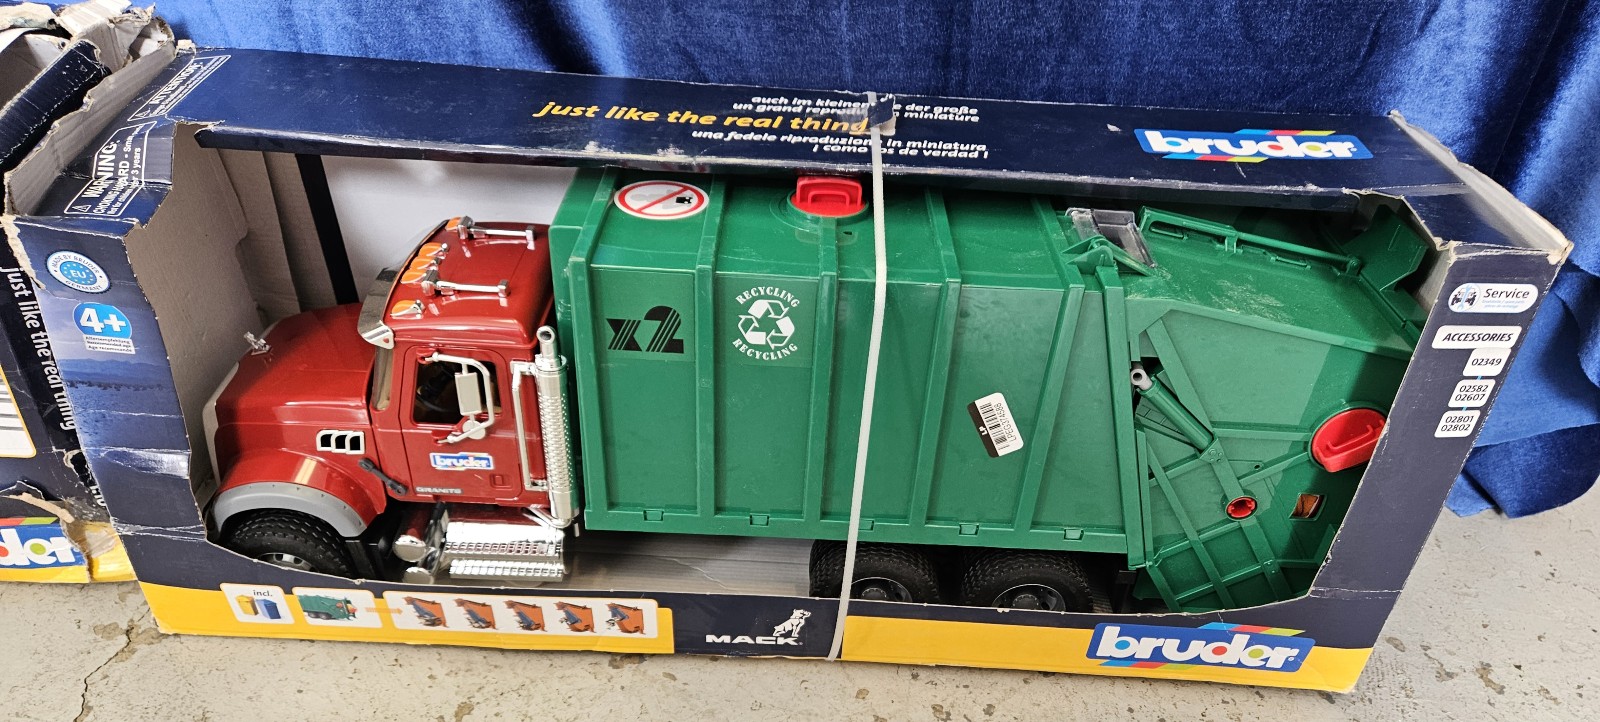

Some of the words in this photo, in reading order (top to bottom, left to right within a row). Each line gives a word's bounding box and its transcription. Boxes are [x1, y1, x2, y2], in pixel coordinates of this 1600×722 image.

[751, 96, 789, 105] auch
[792, 97, 812, 106] im
[905, 103, 931, 112] der
[933, 105, 979, 115] große
[756, 103, 803, 113] grand
[904, 110, 980, 123] miniature
[532, 101, 601, 118] just
[604, 105, 660, 122] like
[667, 110, 717, 125] the
[723, 115, 784, 129] real
[790, 116, 869, 135] thing
[691, 130, 725, 140] una
[724, 130, 778, 142] fedele
[780, 133, 883, 146] riproduzion
[886, 138, 903, 149] in
[906, 140, 987, 151] miniatura
[1143, 130, 1355, 158] bruder
[131, 147, 141, 168] years
[823, 144, 868, 153] como
[898, 147, 919, 156] de
[922, 148, 979, 159] verdad
[70, 269, 87, 278] EU
[735, 286, 800, 308] RECYCLING
[1483, 287, 1530, 299] Service
[79, 307, 126, 333] 4+
[0, 266, 32, 298] just
[17, 300, 41, 329] like
[30, 330, 50, 358] the
[40, 360, 63, 390] real
[1442, 332, 1514, 342] ACCESSORIES
[732, 338, 799, 361] RECYCLING
[1471, 357, 1502, 366] 02349
[1459, 384, 1489, 393] 02582
[1454, 393, 1486, 401] 02607
[1445, 415, 1475, 423] 02801
[1440, 424, 1471, 432] 02802
[435, 455, 489, 467] bruder
[252, 589, 273, 597] incl.
[705, 634, 799, 645] MACK
[1095, 625, 1300, 669] bruder
